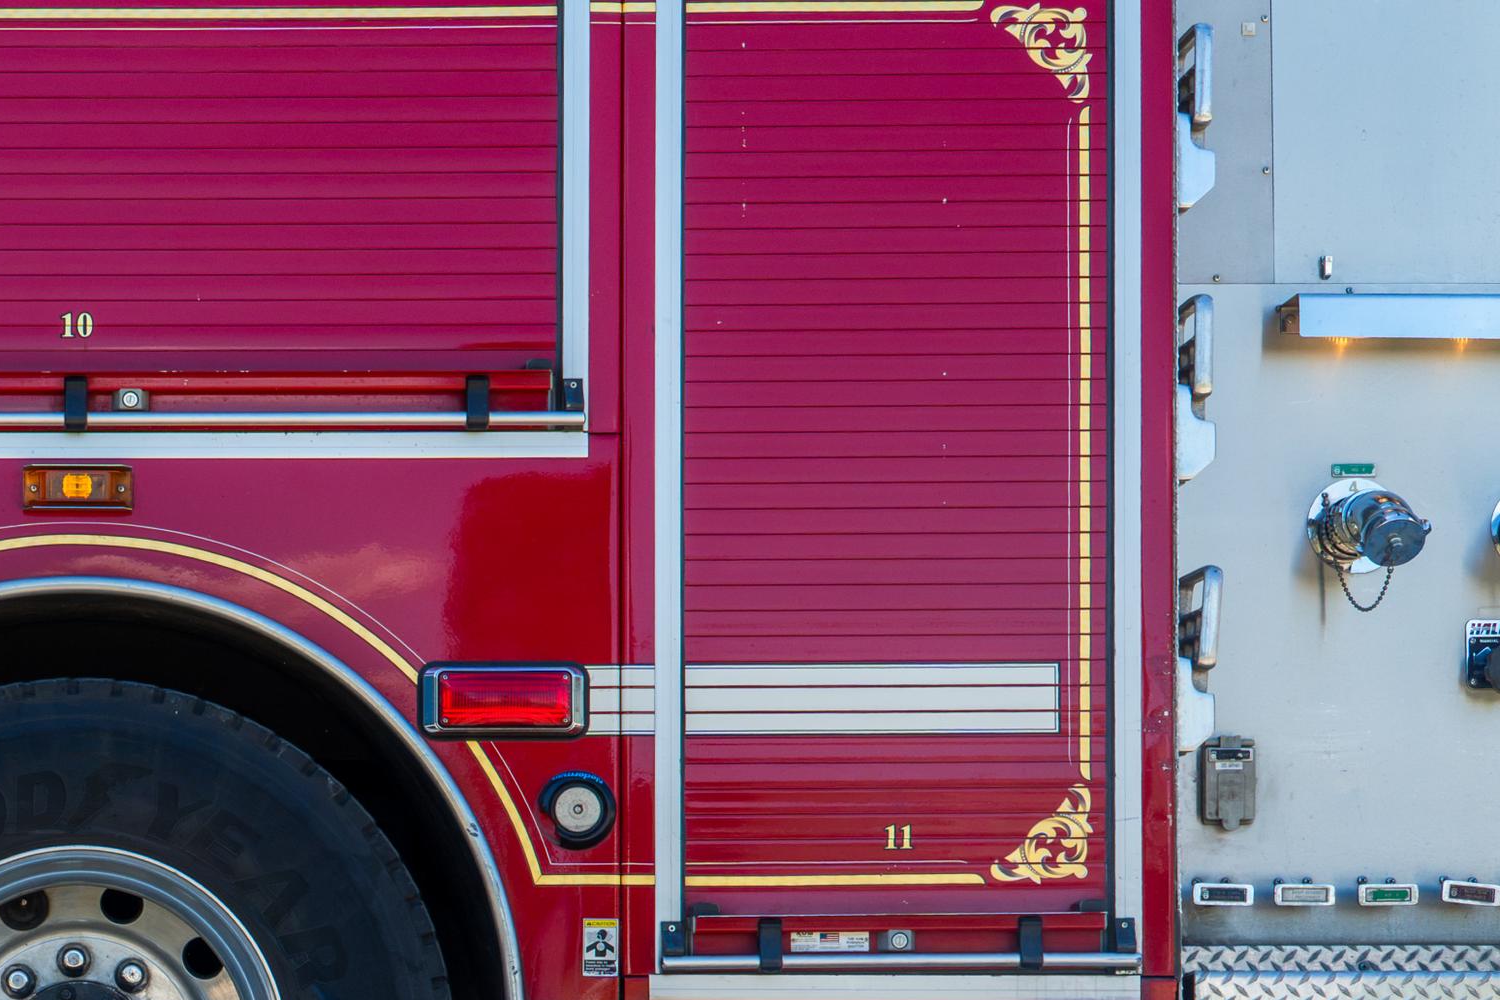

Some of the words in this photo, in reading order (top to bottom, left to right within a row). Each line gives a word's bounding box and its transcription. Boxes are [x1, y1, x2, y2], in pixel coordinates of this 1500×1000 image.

[60, 311, 94, 338] 10
[1348, 480, 1359, 493] 4
[1469, 623, 1500, 635] HAL
[884, 823, 915, 850] 11
